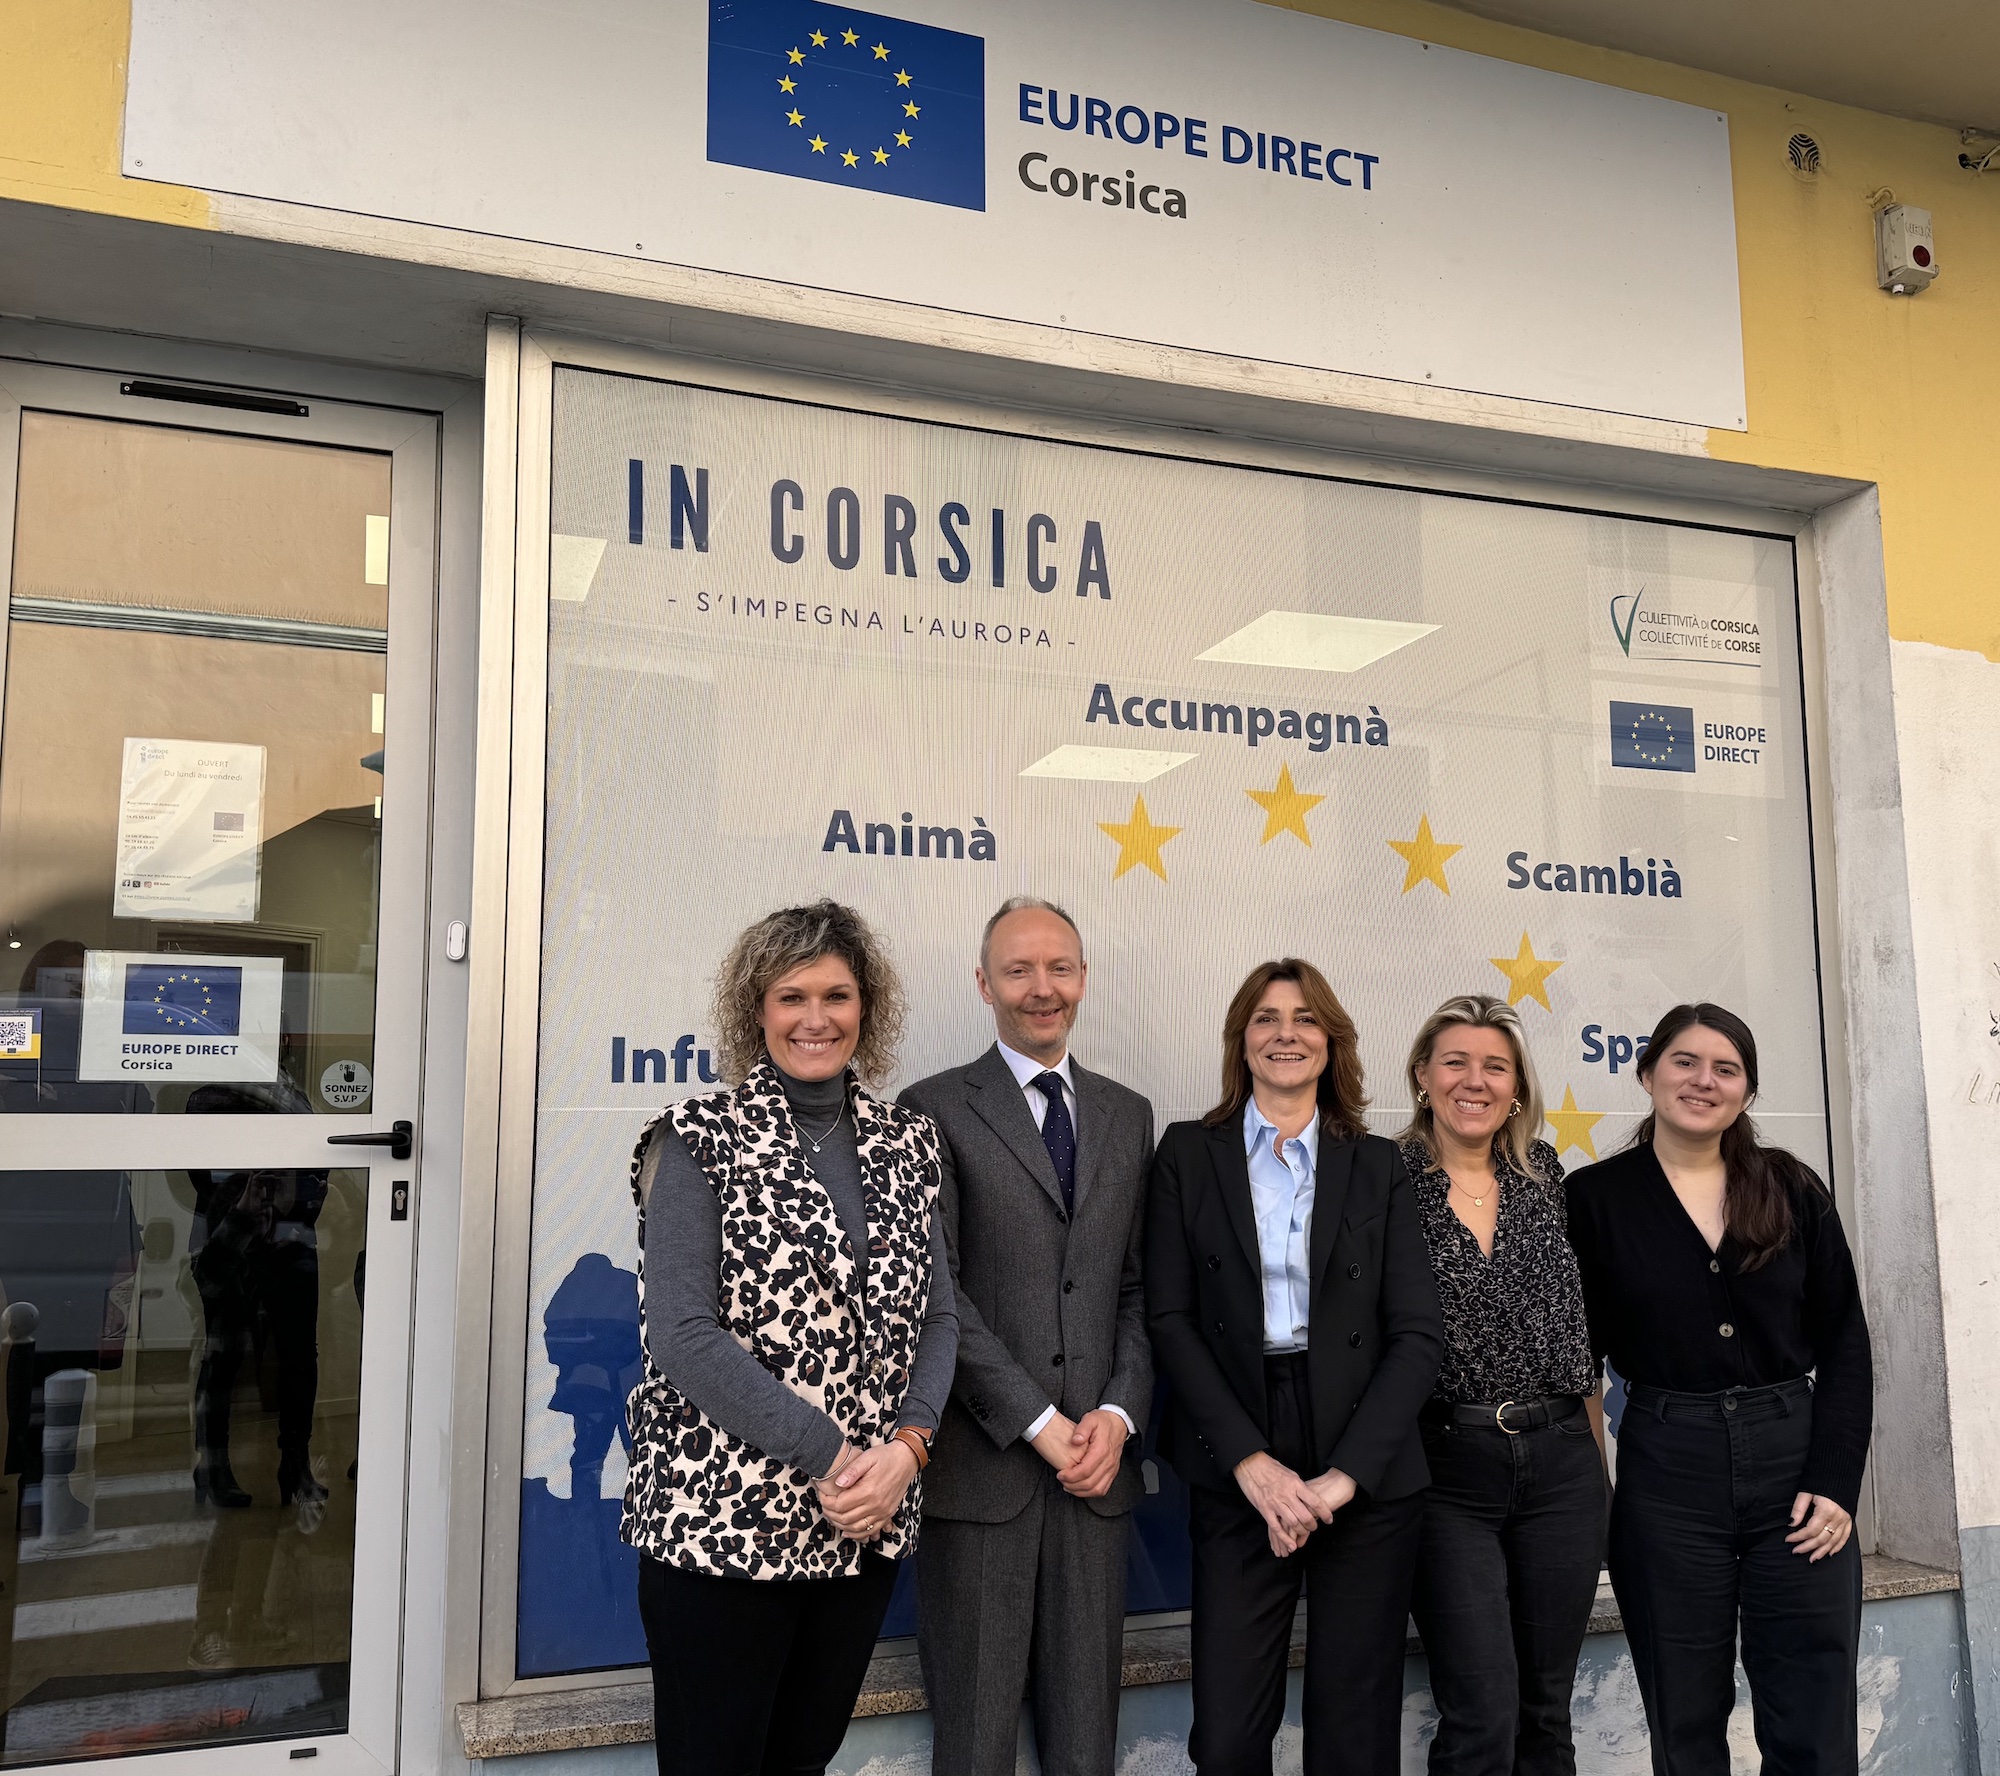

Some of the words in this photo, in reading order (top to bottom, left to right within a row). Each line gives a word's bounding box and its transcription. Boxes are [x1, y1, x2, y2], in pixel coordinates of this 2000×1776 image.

[1018, 82, 1208, 158] EUROPE
[1221, 123, 1380, 191] DIRECT
[1018, 151, 1188, 219] Corsica
[628, 458, 709, 553] IN
[769, 478, 1112, 601] CORSICA
[696, 592, 884, 631] S'IMPEGNA
[903, 614, 1053, 649] L'AUROPA
[1638, 610, 1700, 629] CULLETTIVITÀ
[1700, 620, 1710, 629] DI
[1710, 619, 1760, 636] CORSICA
[1639, 629, 1709, 648] COLLECTIVITÉ
[1711, 639, 1722, 650] DE
[1724, 638, 1761, 654] CORSE
[1085, 682, 1390, 752] Accumpagnà
[1703, 723, 1767, 744] EUROPE
[197, 759, 229, 768] OUVERT
[1703, 745, 1760, 765] DIRECT
[164, 769, 175, 777] Du
[176, 770, 196, 778] lundi
[209, 773, 243, 781] vendredi
[822, 808, 997, 862] Animà
[1506, 850, 1684, 899] Scambià
[121, 1043, 182, 1056] EUROPE
[185, 1044, 239, 1056] DIRECT
[121, 1059, 173, 1071] Corsica
[324, 1084, 368, 1093] SONNEZ
[334, 1094, 358, 1103] S.V.P
